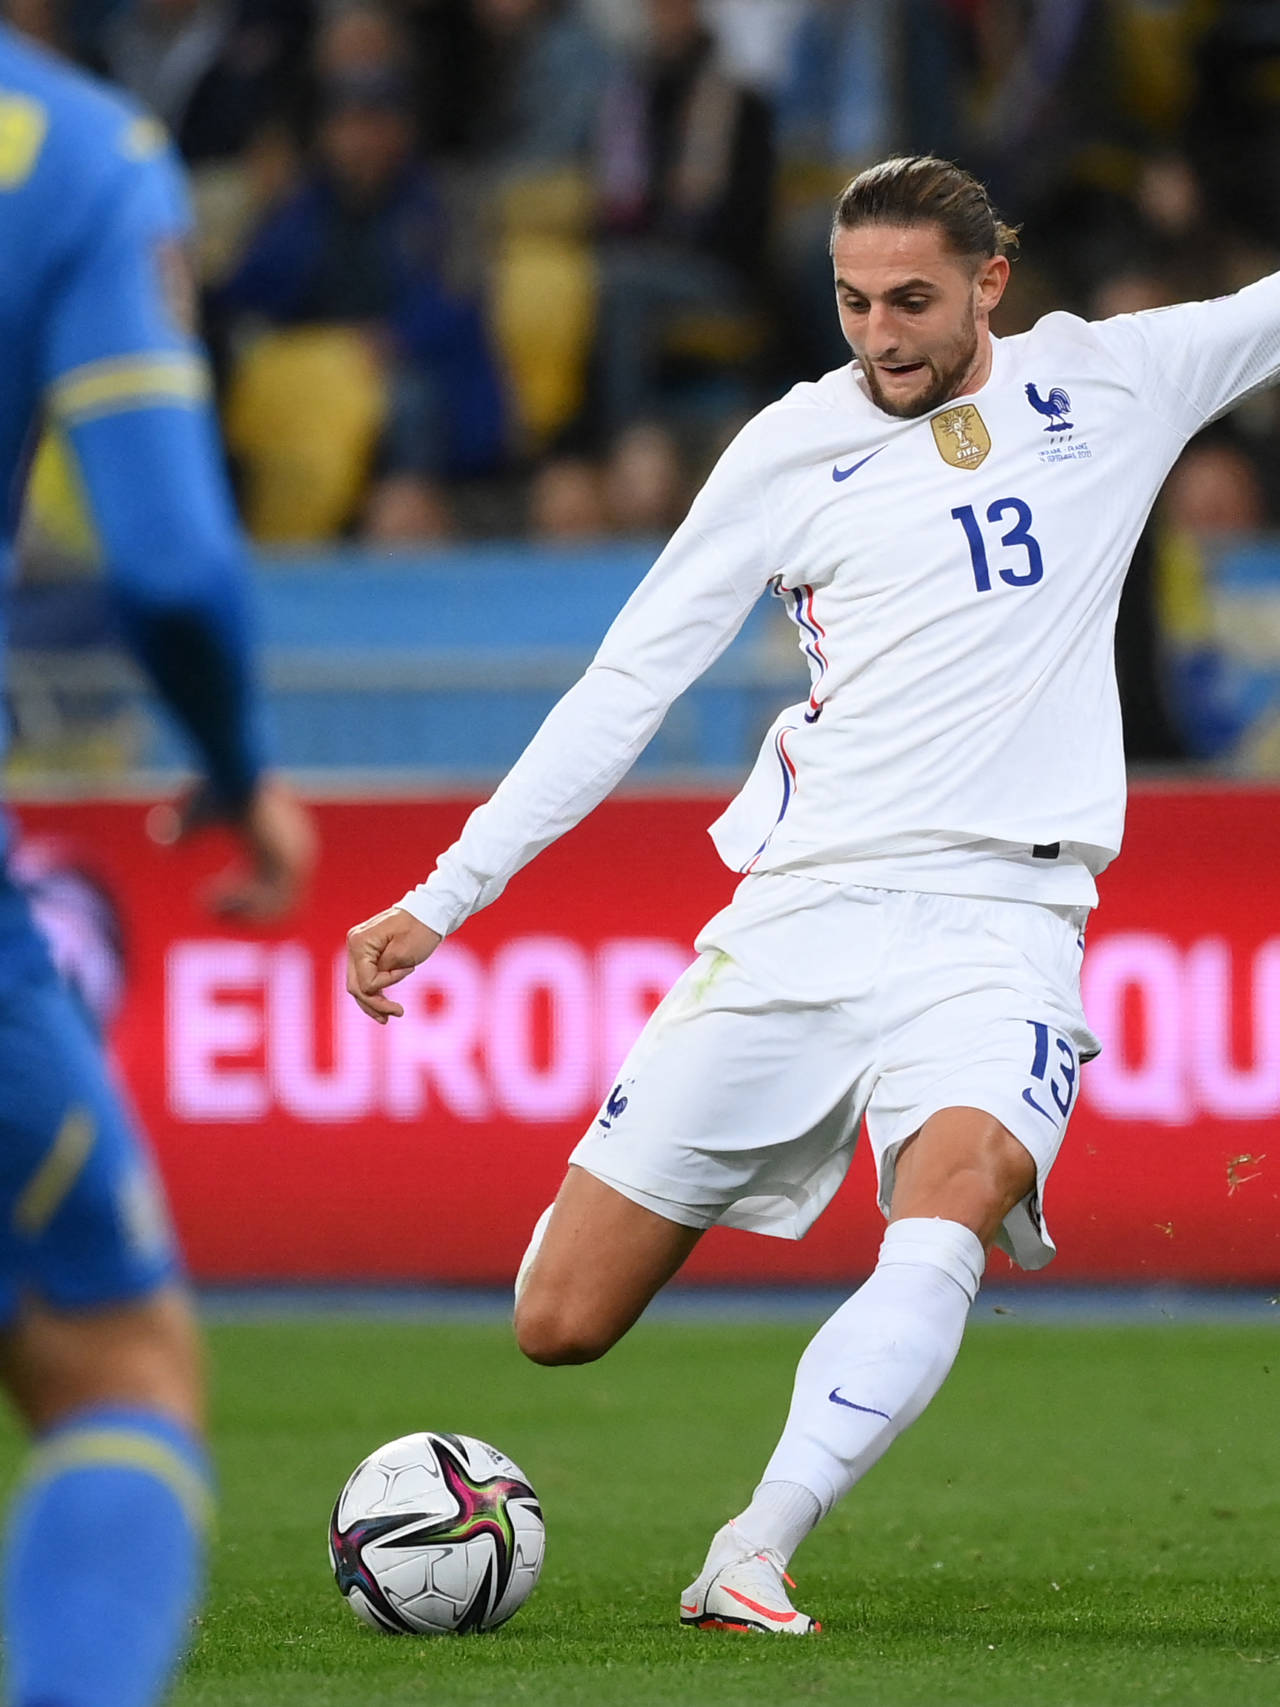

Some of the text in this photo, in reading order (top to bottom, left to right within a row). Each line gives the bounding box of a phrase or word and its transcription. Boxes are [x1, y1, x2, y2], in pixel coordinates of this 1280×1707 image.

[957, 446, 980, 459] FIFA
[951, 497, 1044, 592] 13
[1026, 1019, 1075, 1118] 13
